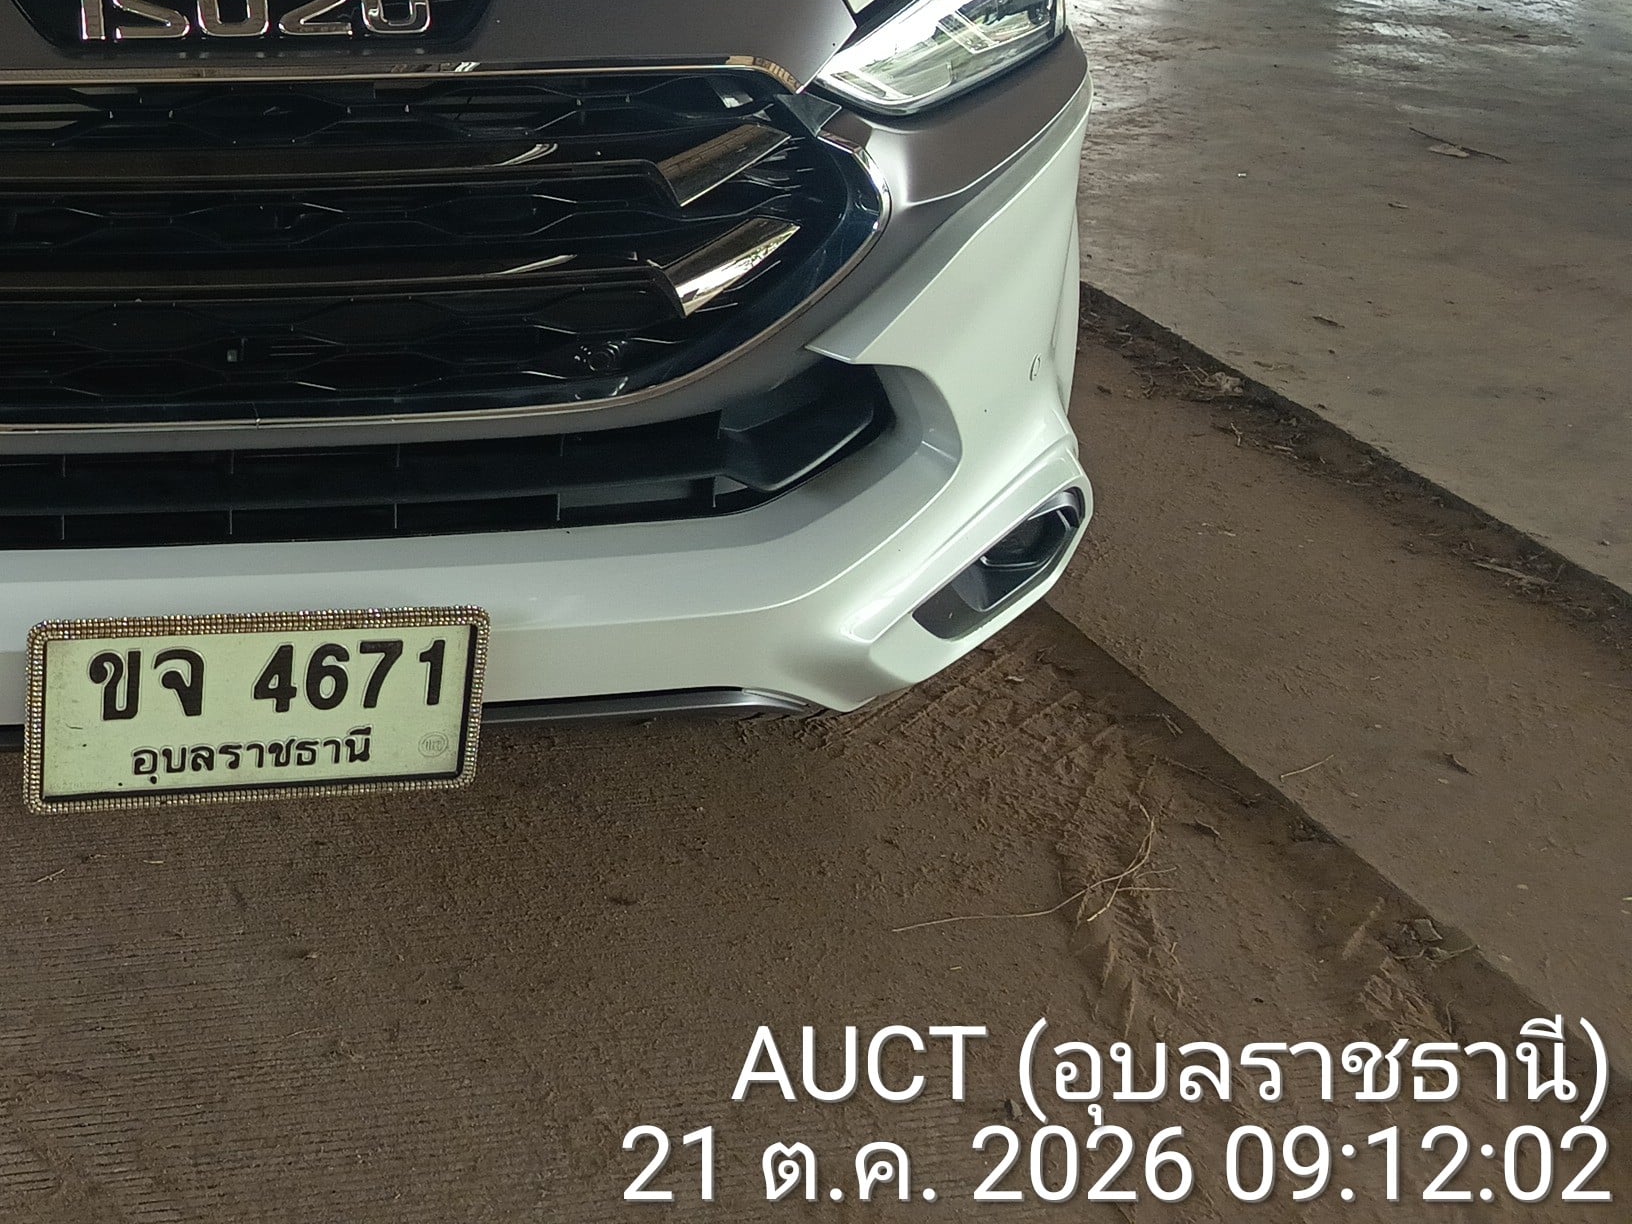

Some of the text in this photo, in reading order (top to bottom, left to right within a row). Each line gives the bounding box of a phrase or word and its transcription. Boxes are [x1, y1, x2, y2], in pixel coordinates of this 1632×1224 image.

[88, 639, 447, 721] ขจ 4671
[132, 726, 372, 784] อุบลราชธานี
